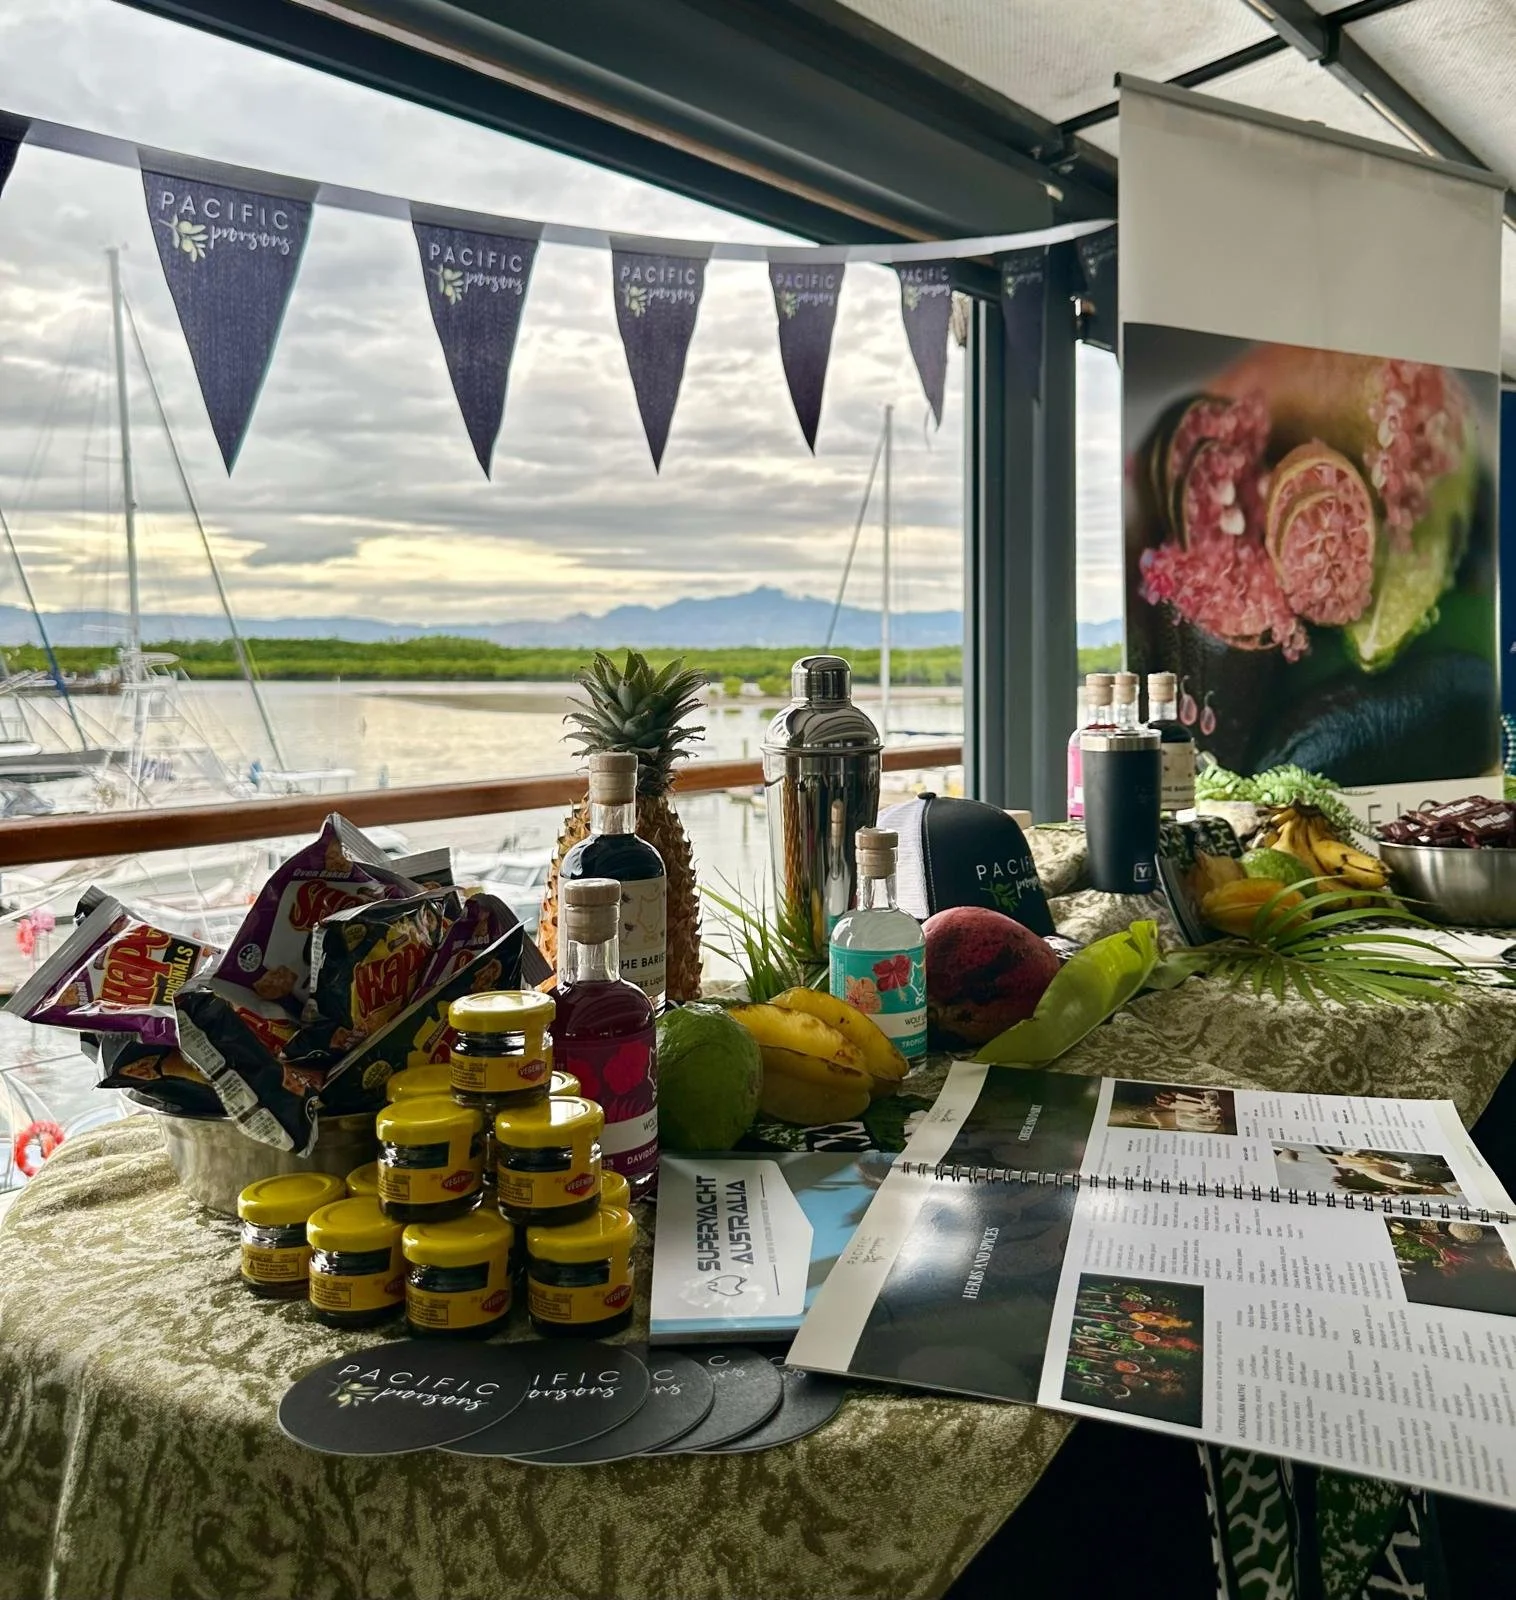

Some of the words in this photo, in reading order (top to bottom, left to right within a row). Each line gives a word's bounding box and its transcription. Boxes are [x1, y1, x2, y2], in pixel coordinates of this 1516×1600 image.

[160, 191, 289, 230] PACIFIC
[430, 243, 522, 272] PACIFIC
[620, 266, 696, 285] PACIFIC
[775, 273, 836, 289] PACIFIC
[696, 1175, 721, 1272] SUPERYACHT
[726, 1179, 754, 1265] AUSTRALIA
[979, 1226, 1000, 1251] SPICES
[973, 1251, 991, 1270] AND
[962, 1270, 985, 1299] HERBS
[338, 1364, 500, 1395] PACIFIC
[532, 1370, 620, 1386] IFIC
[371, 1386, 489, 1411] provisions
[1237, 1384, 1246, 1403] NATIVE
[1237, 1404, 1246, 1439] AUSTRALIAN
